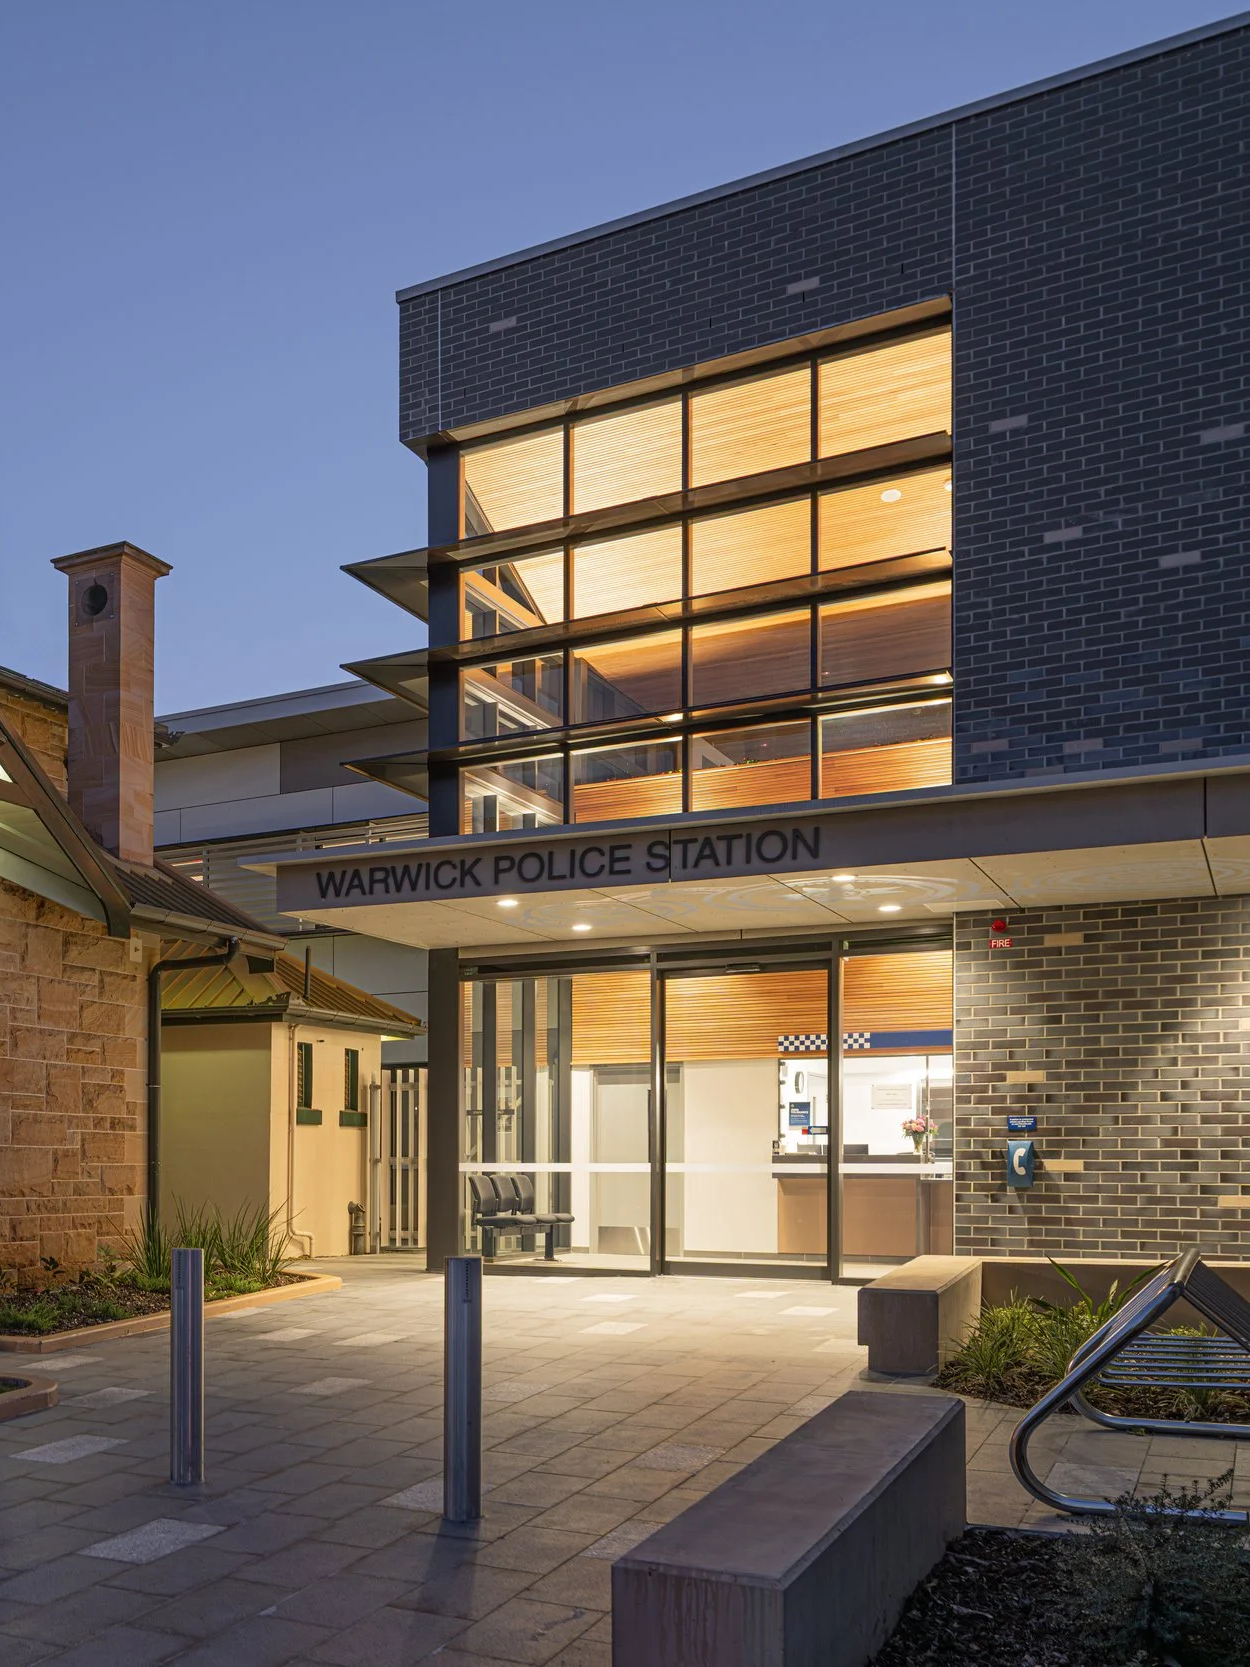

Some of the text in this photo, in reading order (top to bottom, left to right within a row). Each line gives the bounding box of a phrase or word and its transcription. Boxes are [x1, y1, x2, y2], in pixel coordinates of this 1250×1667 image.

[316, 826, 820, 899] WARWICK POLICE STATION
[991, 939, 1010, 948] FIRE
